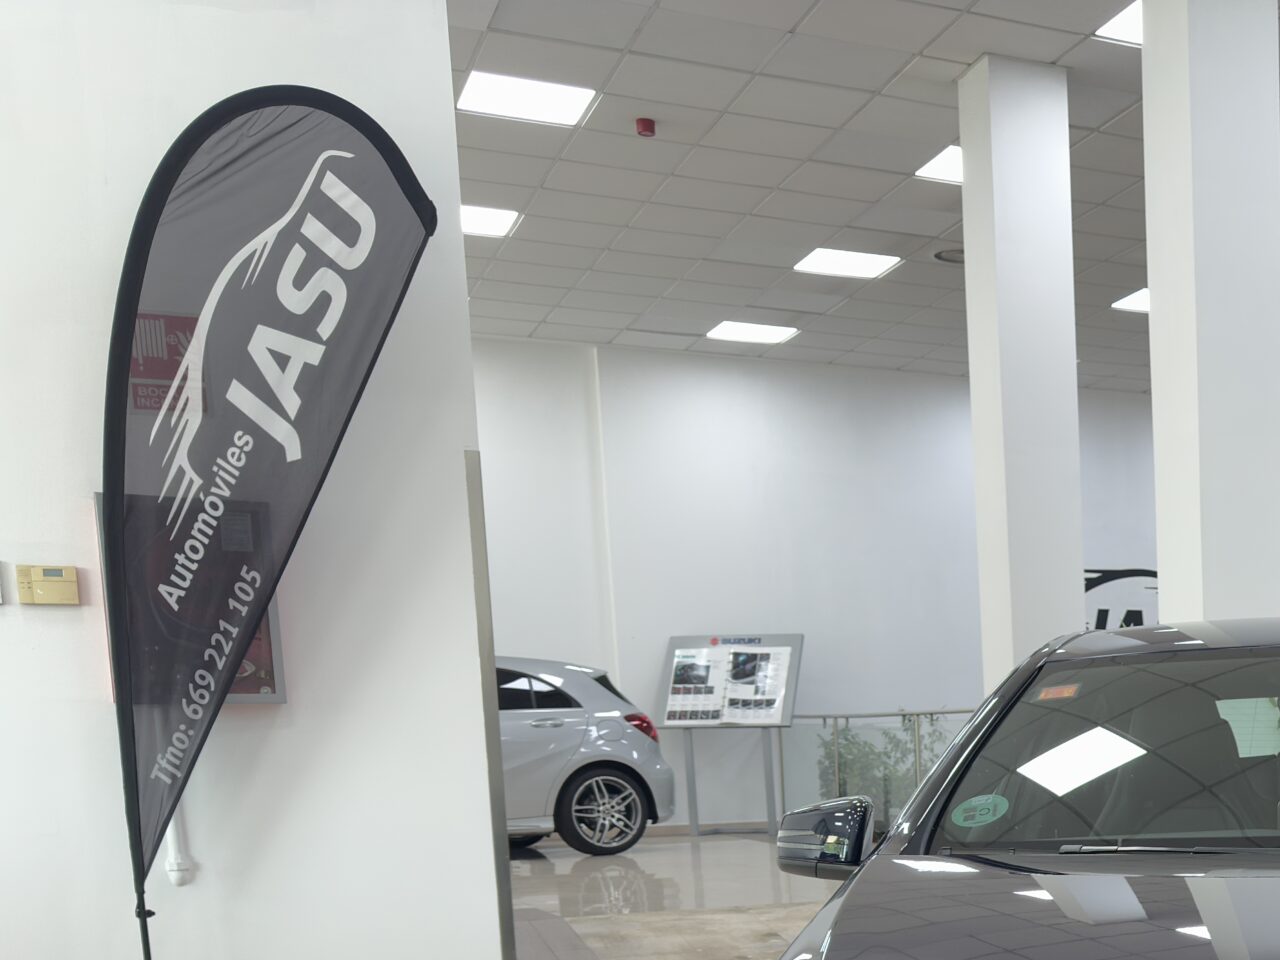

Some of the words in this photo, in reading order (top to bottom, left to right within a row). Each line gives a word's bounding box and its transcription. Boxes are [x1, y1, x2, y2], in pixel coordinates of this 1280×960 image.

[226, 170, 376, 462] JASU
[157, 430, 254, 612] Automóviles
[150, 723, 194, 785] Tfno:
[182, 669, 215, 720] 669
[204, 619, 239, 670] 221
[228, 564, 261, 617] 105
